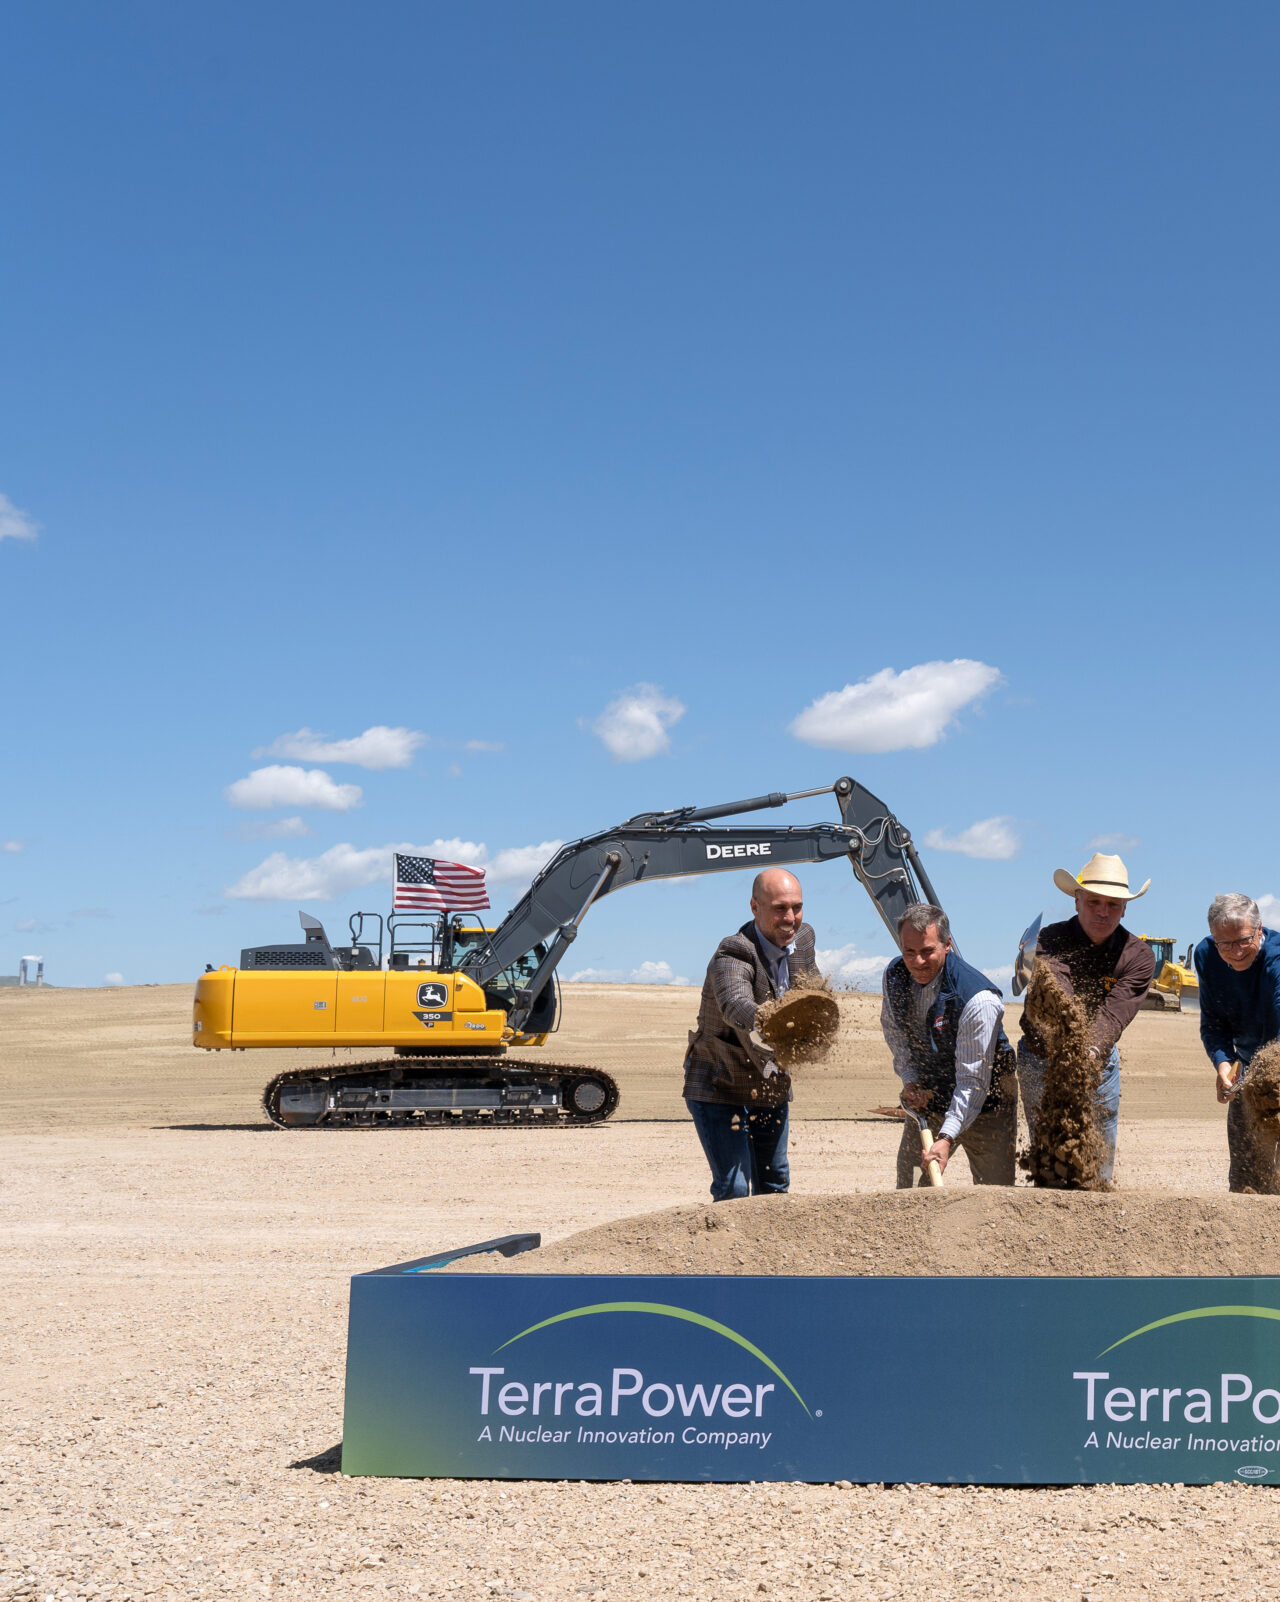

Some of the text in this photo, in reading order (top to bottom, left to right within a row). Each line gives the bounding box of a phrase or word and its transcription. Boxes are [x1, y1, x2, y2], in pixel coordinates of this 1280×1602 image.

[706, 843, 772, 859] DEERE
[470, 1367, 774, 1418] TerraPower
[477, 1425, 772, 1450] A Nuclear Innovation Company
[1084, 1432, 1099, 1449] A
[1107, 1431, 1181, 1450] Nuclear
